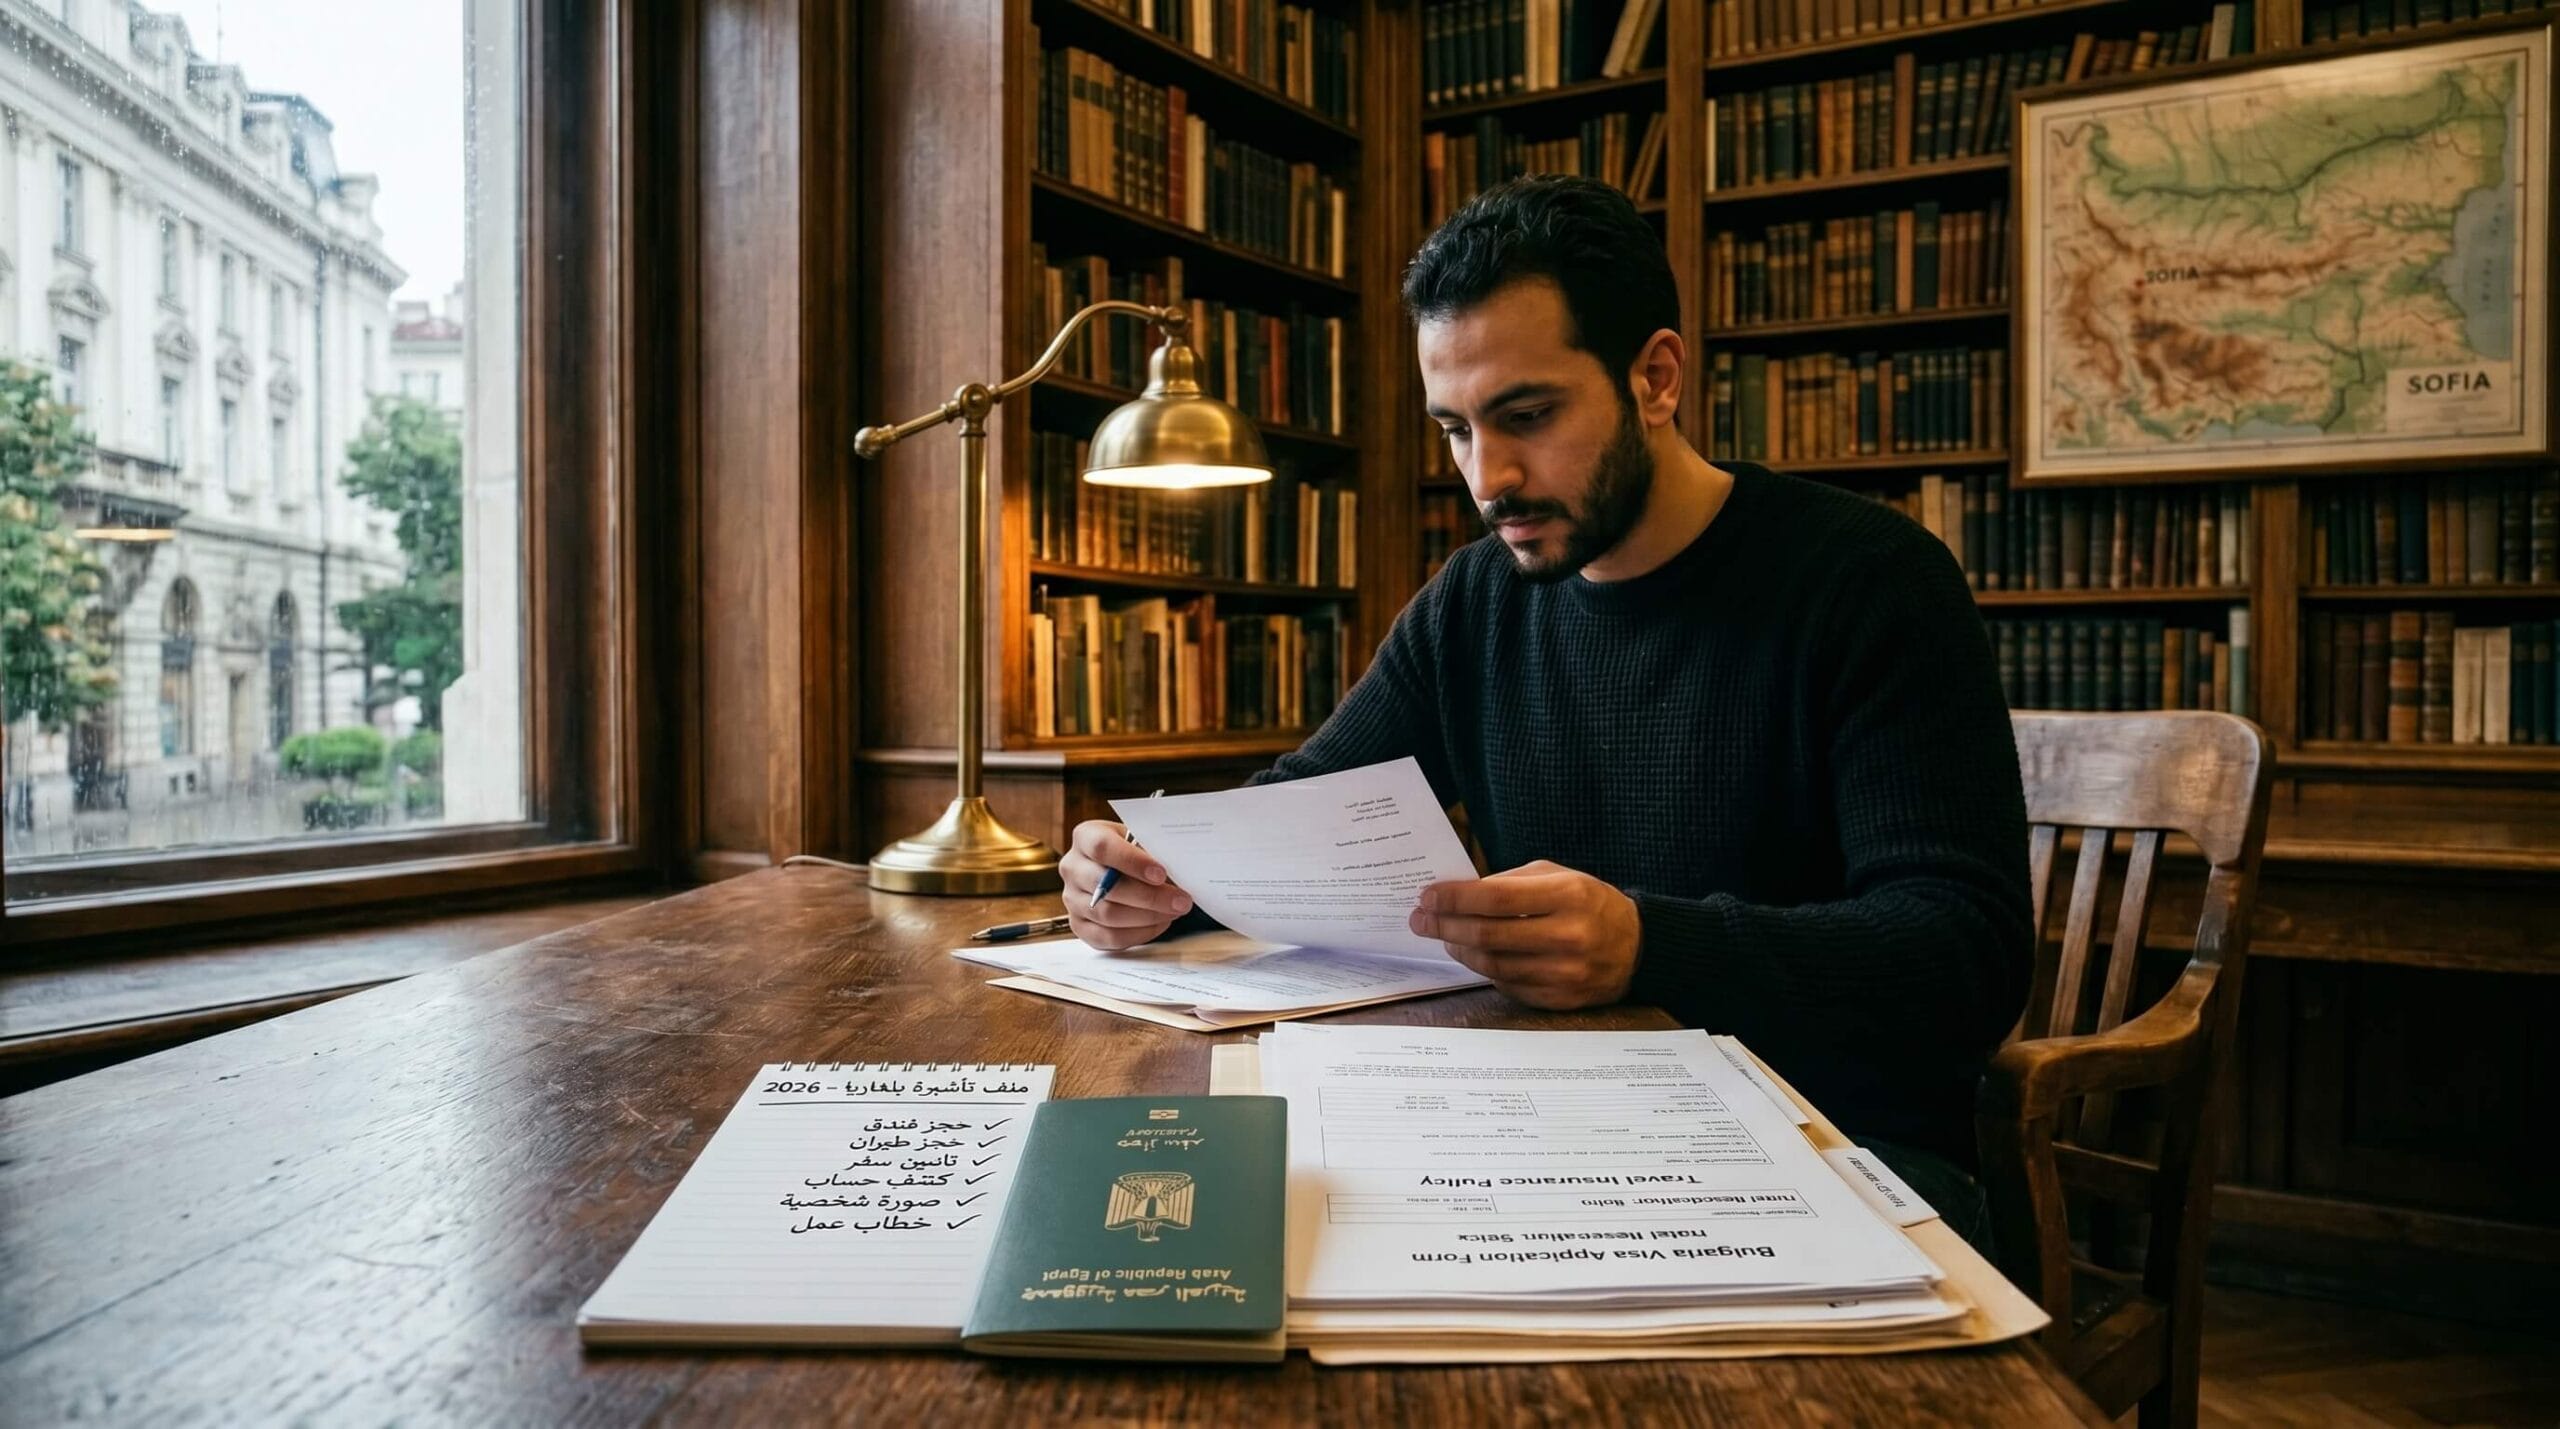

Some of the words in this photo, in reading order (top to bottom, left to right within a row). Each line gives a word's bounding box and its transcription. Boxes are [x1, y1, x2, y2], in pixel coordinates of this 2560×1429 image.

[2407, 370, 2491, 394] SOFIA
[763, 1082, 820, 1093] 2026
[845, 1156, 892, 1170] سفر
[805, 1174, 880, 1189] حساب
[1626, 1176, 1701, 1185] Travel
[780, 1194, 870, 1210] شخصية
[878, 1195, 940, 1212] صورة
[791, 1216, 844, 1233] عمل
[854, 1216, 931, 1233] خطاب
[1412, 1254, 1471, 1263] Form
